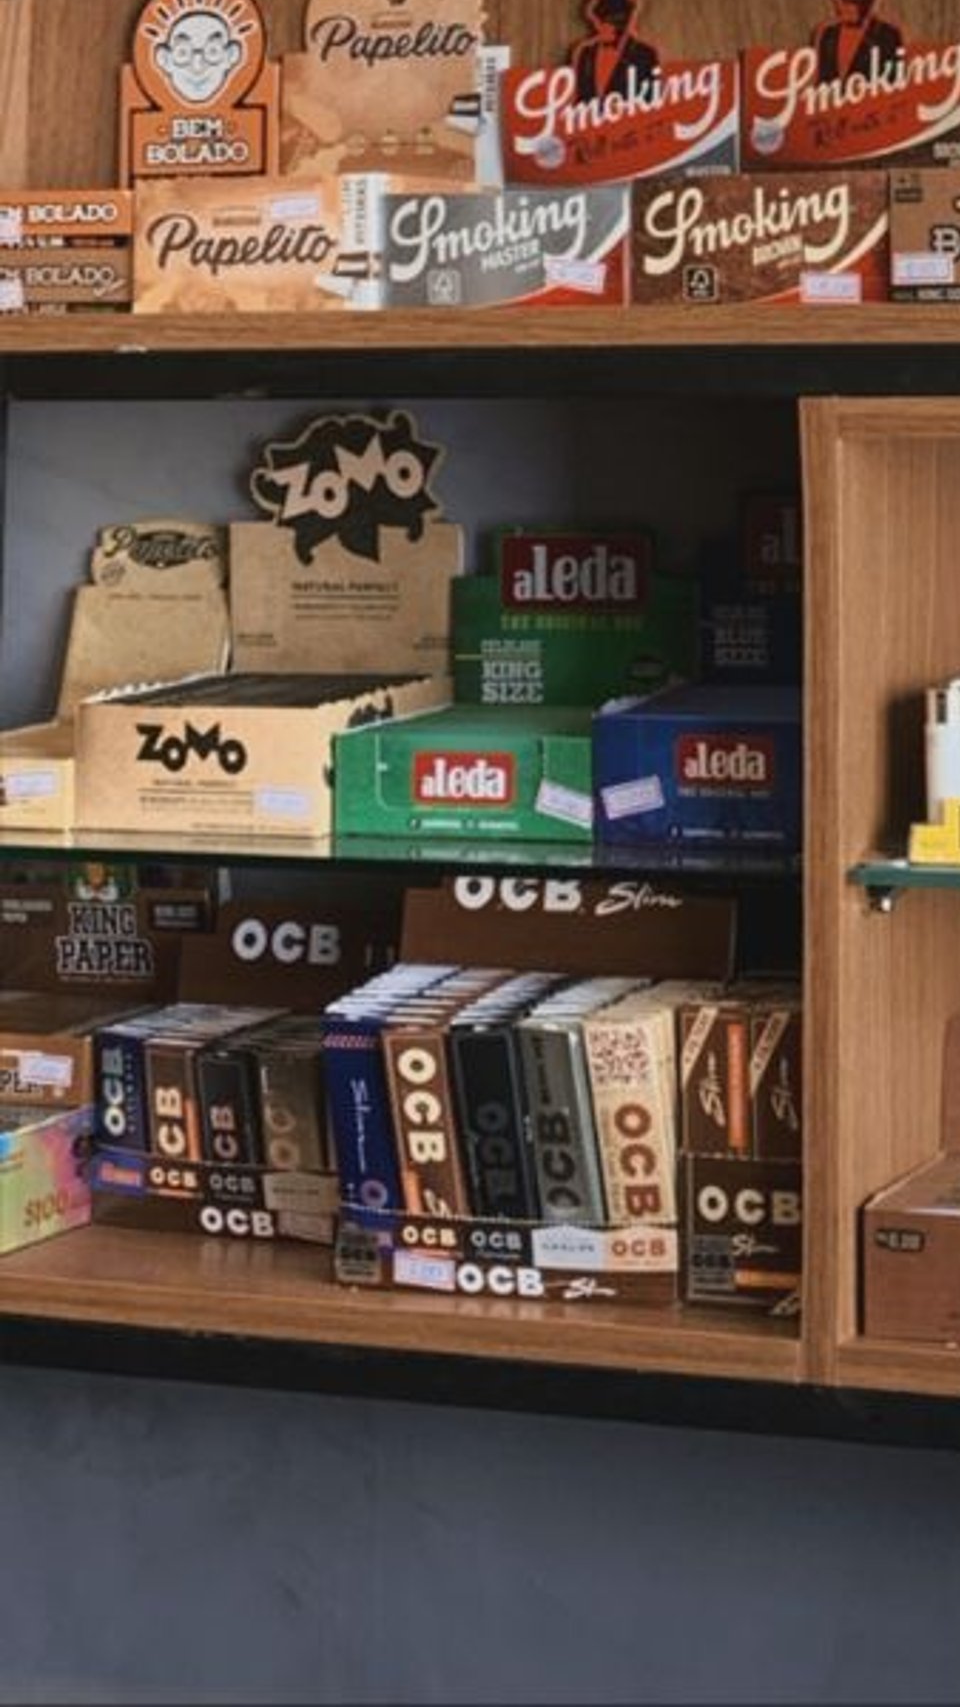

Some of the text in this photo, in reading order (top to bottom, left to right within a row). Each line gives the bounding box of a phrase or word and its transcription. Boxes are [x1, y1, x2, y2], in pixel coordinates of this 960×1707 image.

[310, 15, 478, 63] Papelito
[513, 61, 723, 156] Smoking
[172, 119, 225, 139] BEM
[145, 141, 249, 166] BOLADO
[28, 203, 118, 223] BOLADO
[642, 183, 850, 275] Smoking
[146, 212, 336, 275] Papelito
[389, 194, 588, 283] Smoking
[480, 238, 542, 273] MASTER
[26, 266, 116, 287] BOLADO
[270, 432, 426, 520] ZOMO
[481, 660, 545, 681] KING
[481, 682, 545, 704] SIZE
[136, 719, 248, 776] ZOMO
[453, 876, 584, 912] OCB
[67, 901, 137, 937] KING
[55, 935, 155, 974] PAPER
[231, 917, 342, 966] OCB
[155, 1084, 187, 1156] CB
[396, 1047, 447, 1165] OCB
[149, 1165, 198, 1189] OCB
[612, 1102, 664, 1219] OCB
[199, 1205, 276, 1238] OCB
[697, 1184, 800, 1227] OCB
[401, 1224, 458, 1247] OCB
[470, 1230, 524, 1250] OCB
[610, 1237, 667, 1257] OCB
[456, 1262, 546, 1297] OCB
